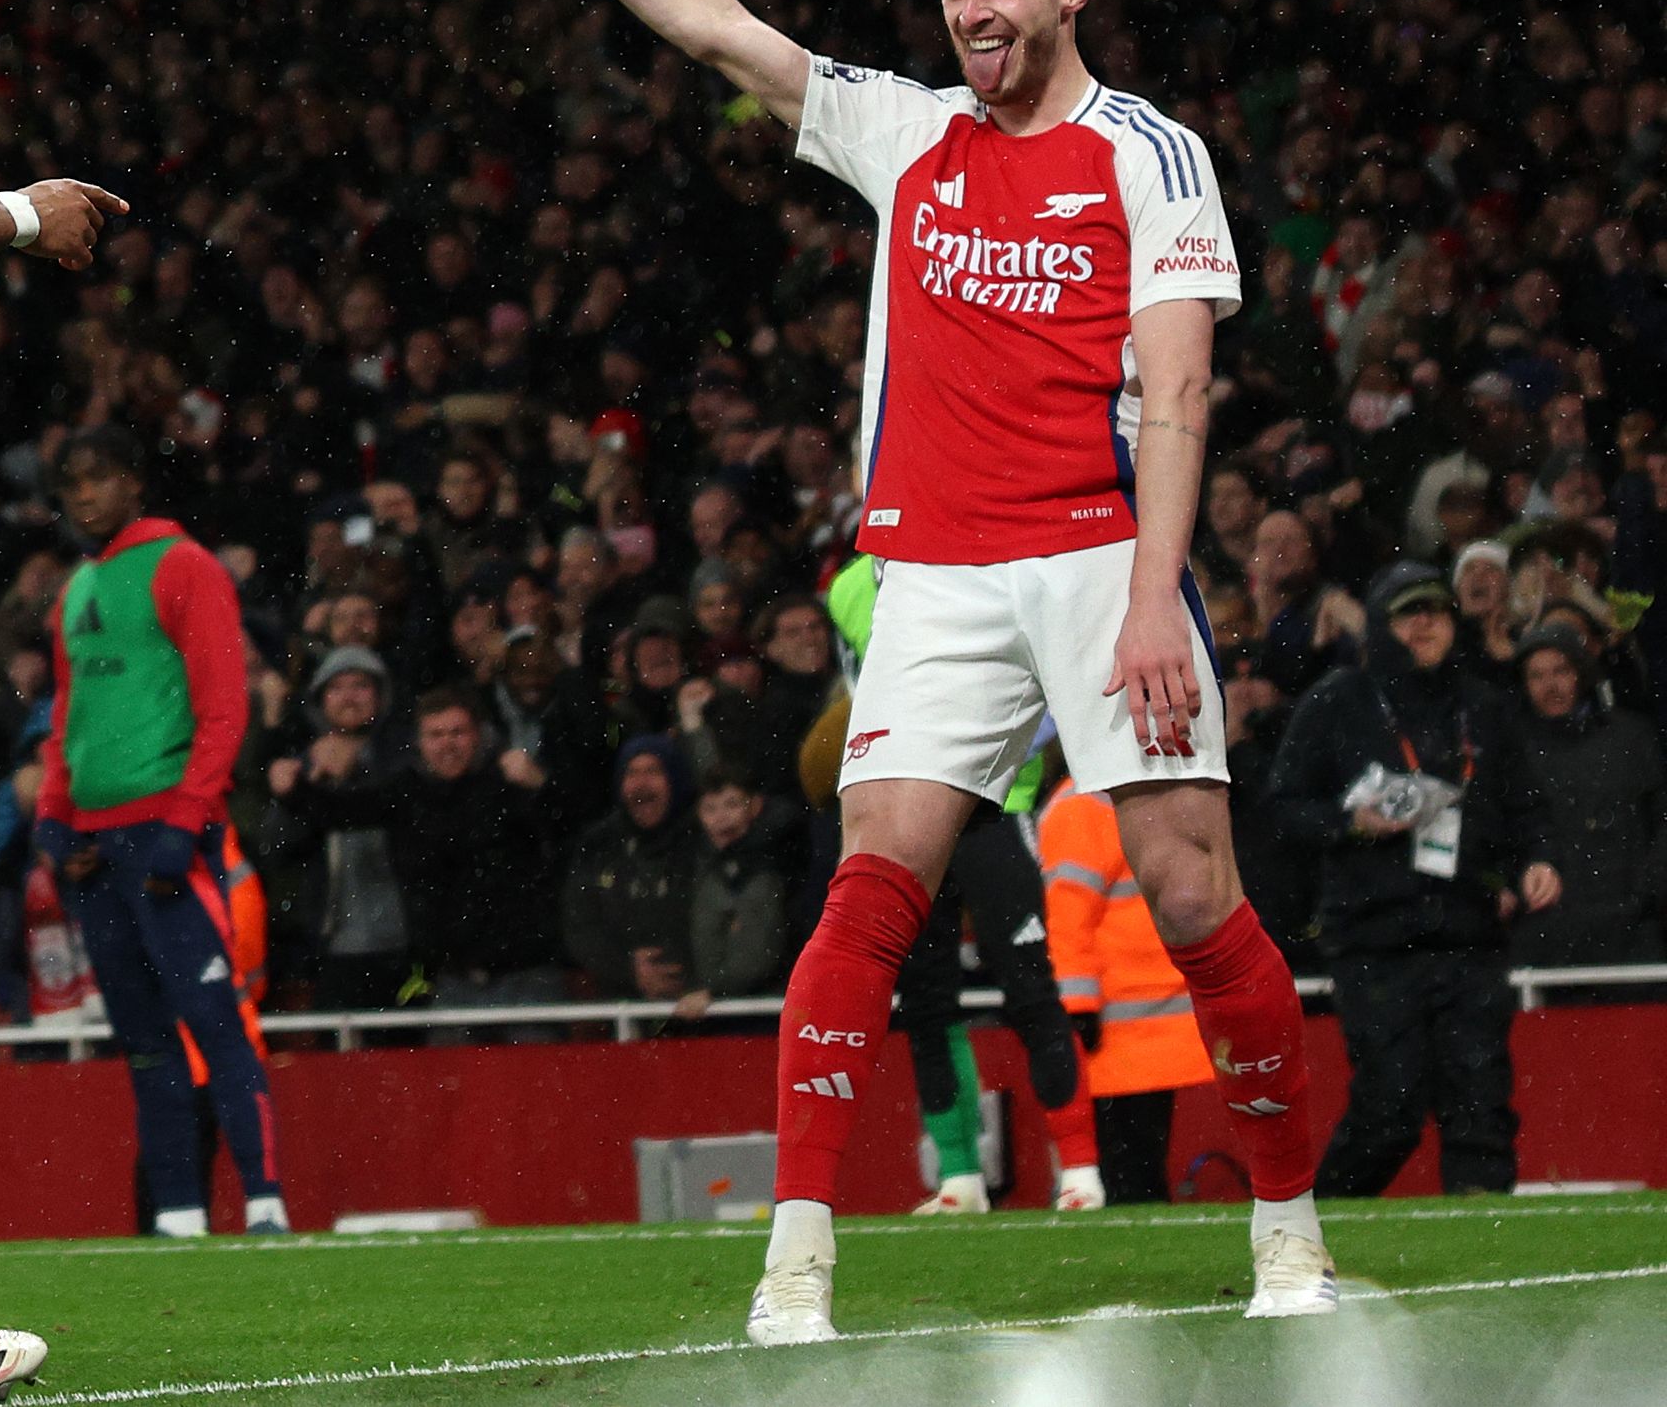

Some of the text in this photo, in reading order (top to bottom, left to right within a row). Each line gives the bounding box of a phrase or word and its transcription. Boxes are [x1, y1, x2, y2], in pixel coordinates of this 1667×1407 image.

[913, 202, 1095, 283] Emirates
[1175, 237, 1219, 255] VISIT
[1154, 255, 1239, 275] RWANDA
[961, 277, 1063, 315] BETTER
[797, 1023, 867, 1048] AFC
